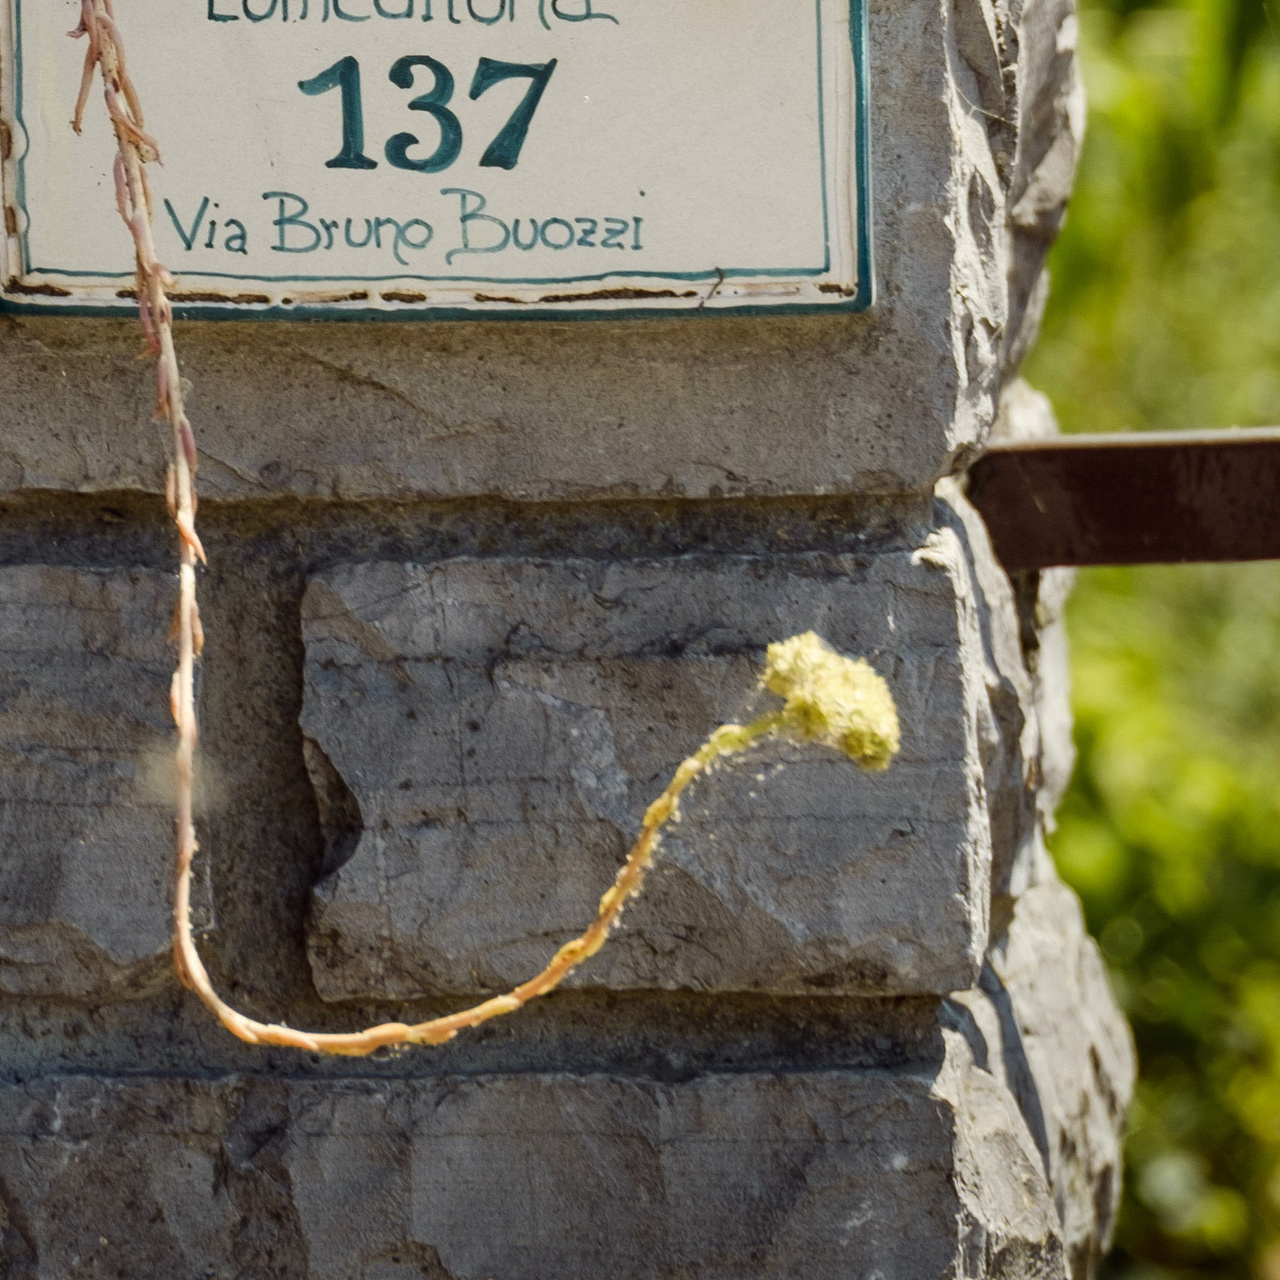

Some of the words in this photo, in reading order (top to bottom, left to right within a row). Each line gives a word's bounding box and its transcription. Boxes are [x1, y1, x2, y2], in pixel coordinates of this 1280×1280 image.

[297, 54, 558, 174] 137
[164, 195, 248, 256] Via
[261, 191, 434, 266] Bruno
[440, 187, 647, 266] Buozzi
